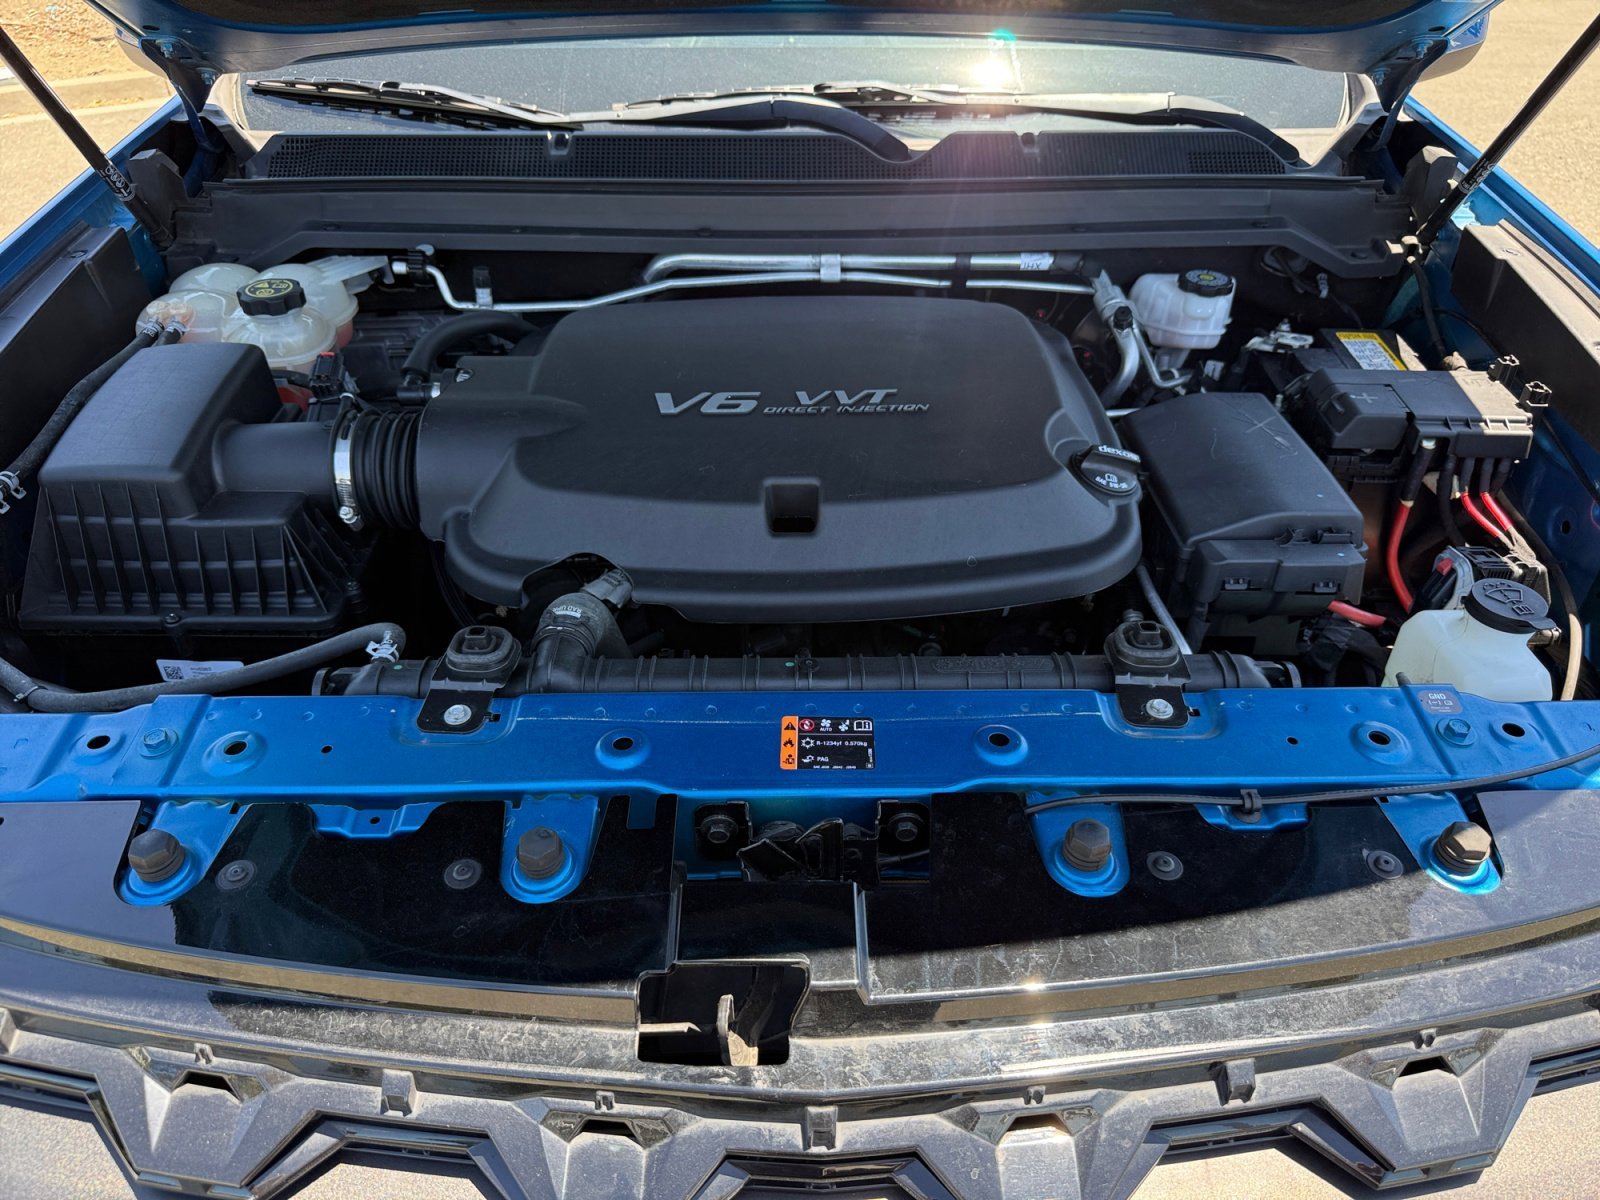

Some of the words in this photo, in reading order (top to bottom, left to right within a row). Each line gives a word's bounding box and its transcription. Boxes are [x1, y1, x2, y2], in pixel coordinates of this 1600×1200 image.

[655, 392, 761, 415] V6
[795, 388, 898, 405] VVT
[763, 406, 830, 415] DIRECT
[836, 403, 930, 414] INJECTION
